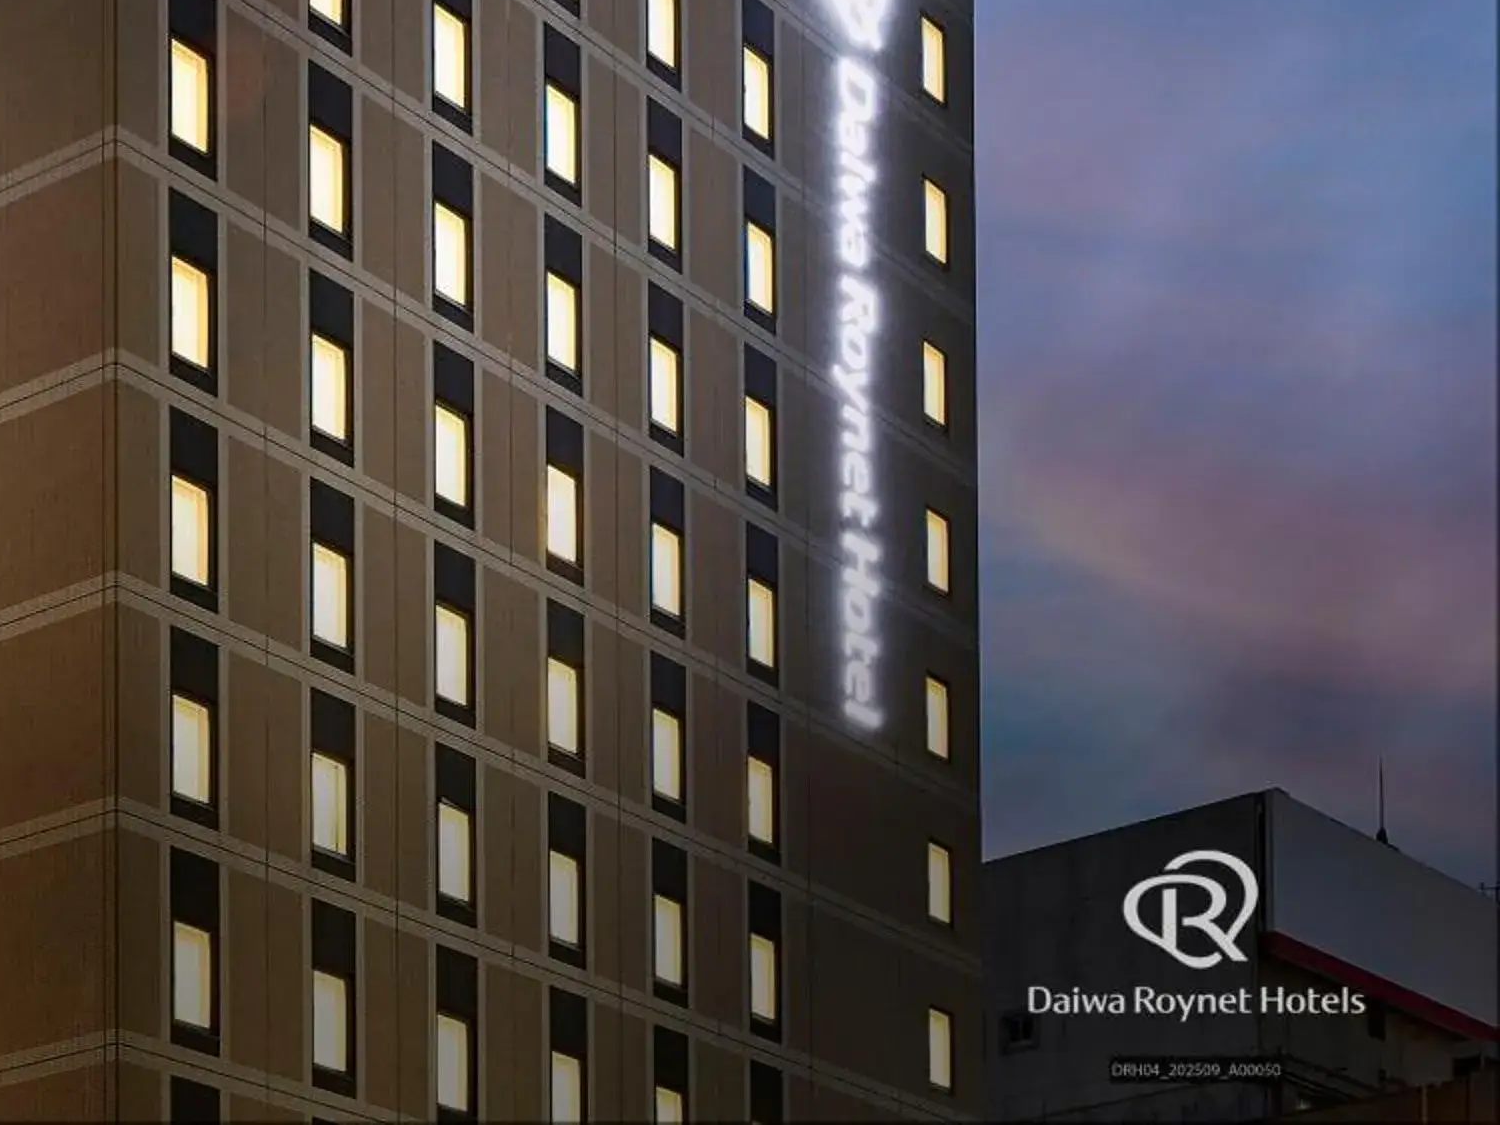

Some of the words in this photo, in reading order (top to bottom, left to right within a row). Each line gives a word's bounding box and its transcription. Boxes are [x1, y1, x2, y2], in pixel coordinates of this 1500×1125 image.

[835, 56, 879, 268] Daiwa
[832, 274, 881, 529] Roynet
[840, 530, 885, 730] Hotel
